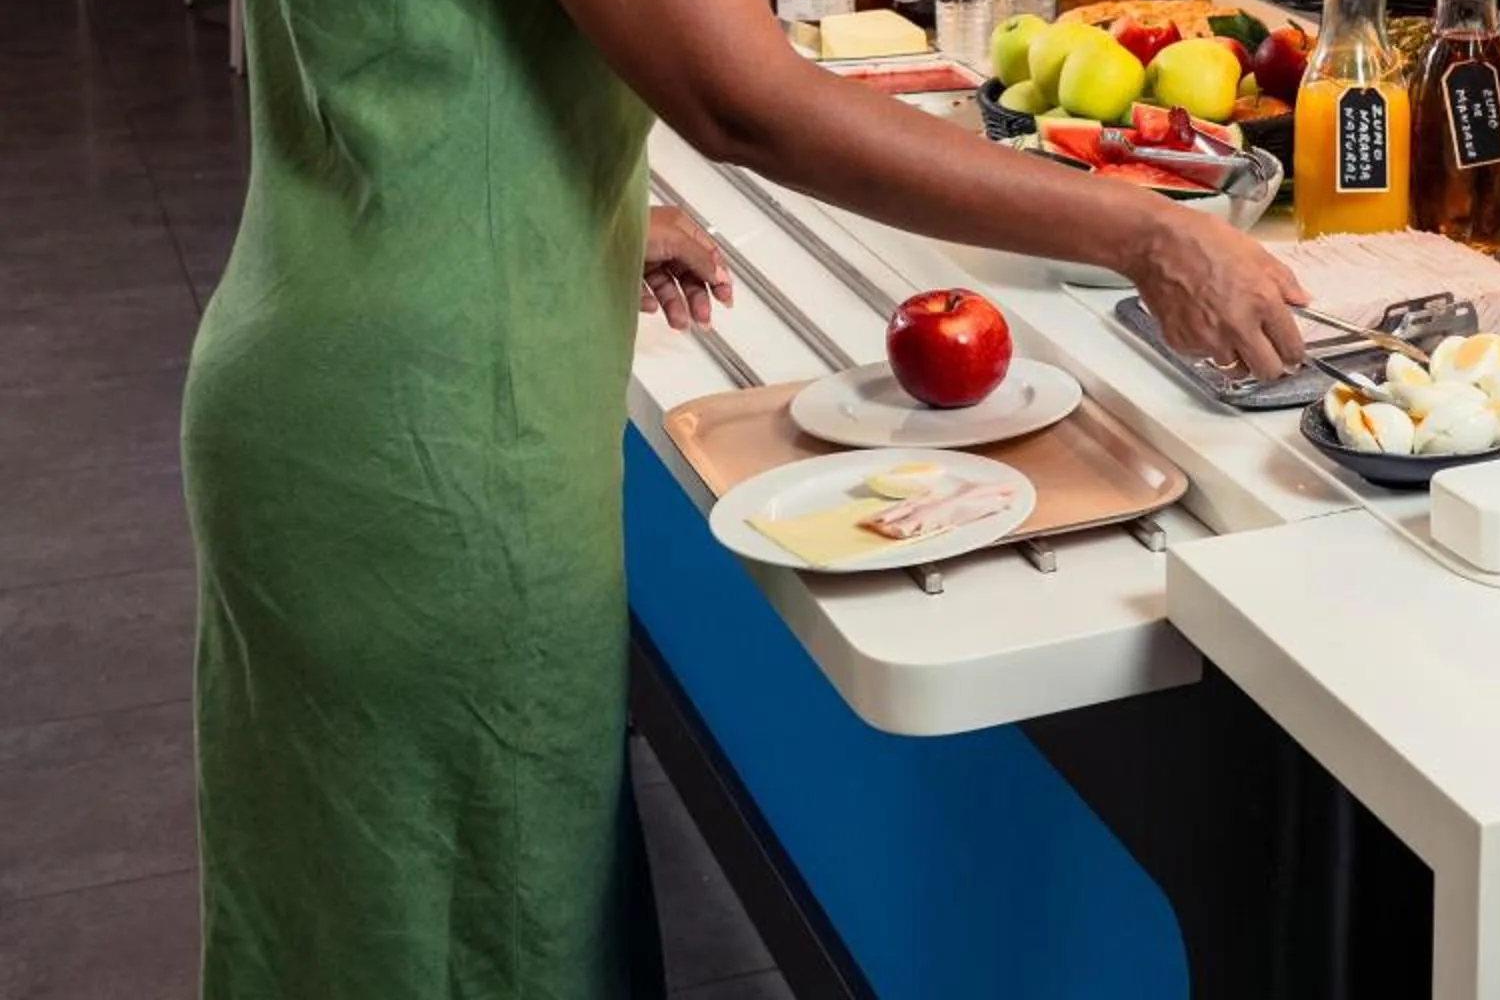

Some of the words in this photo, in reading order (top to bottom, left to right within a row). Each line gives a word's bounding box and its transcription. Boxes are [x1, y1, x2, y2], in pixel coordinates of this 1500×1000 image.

[1371, 103, 1384, 161] ZUMO
[1455, 89, 1477, 158] MANZANA
[1482, 88, 1499, 129] ZUMO
[1343, 107, 1357, 183] NATURAL
[1358, 109, 1372, 181] NARANJA
